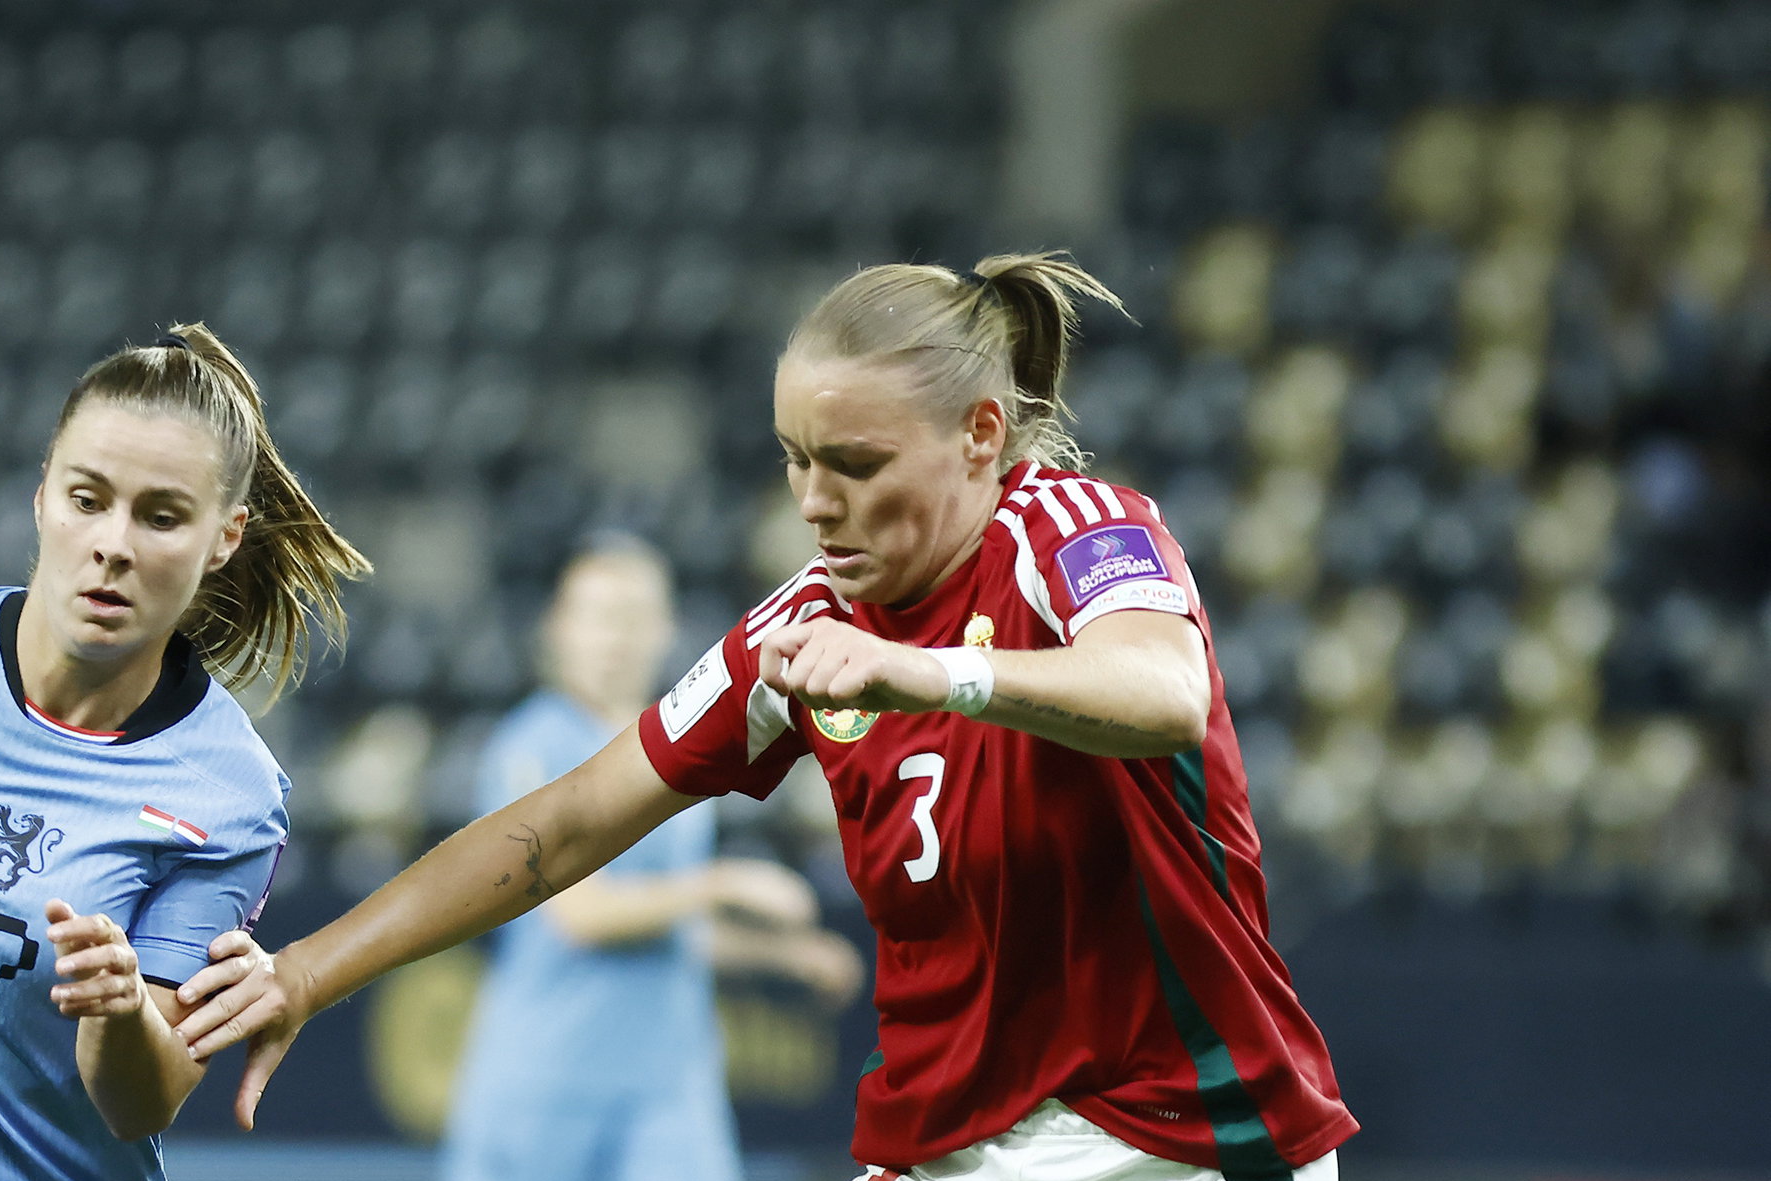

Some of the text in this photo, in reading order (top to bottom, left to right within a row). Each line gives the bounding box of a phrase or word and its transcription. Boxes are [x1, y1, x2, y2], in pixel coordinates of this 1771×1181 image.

[1077, 557, 1153, 586] EUROPEAN
[1079, 565, 1158, 595] QUALIFIERS
[898, 751, 946, 883] 3
